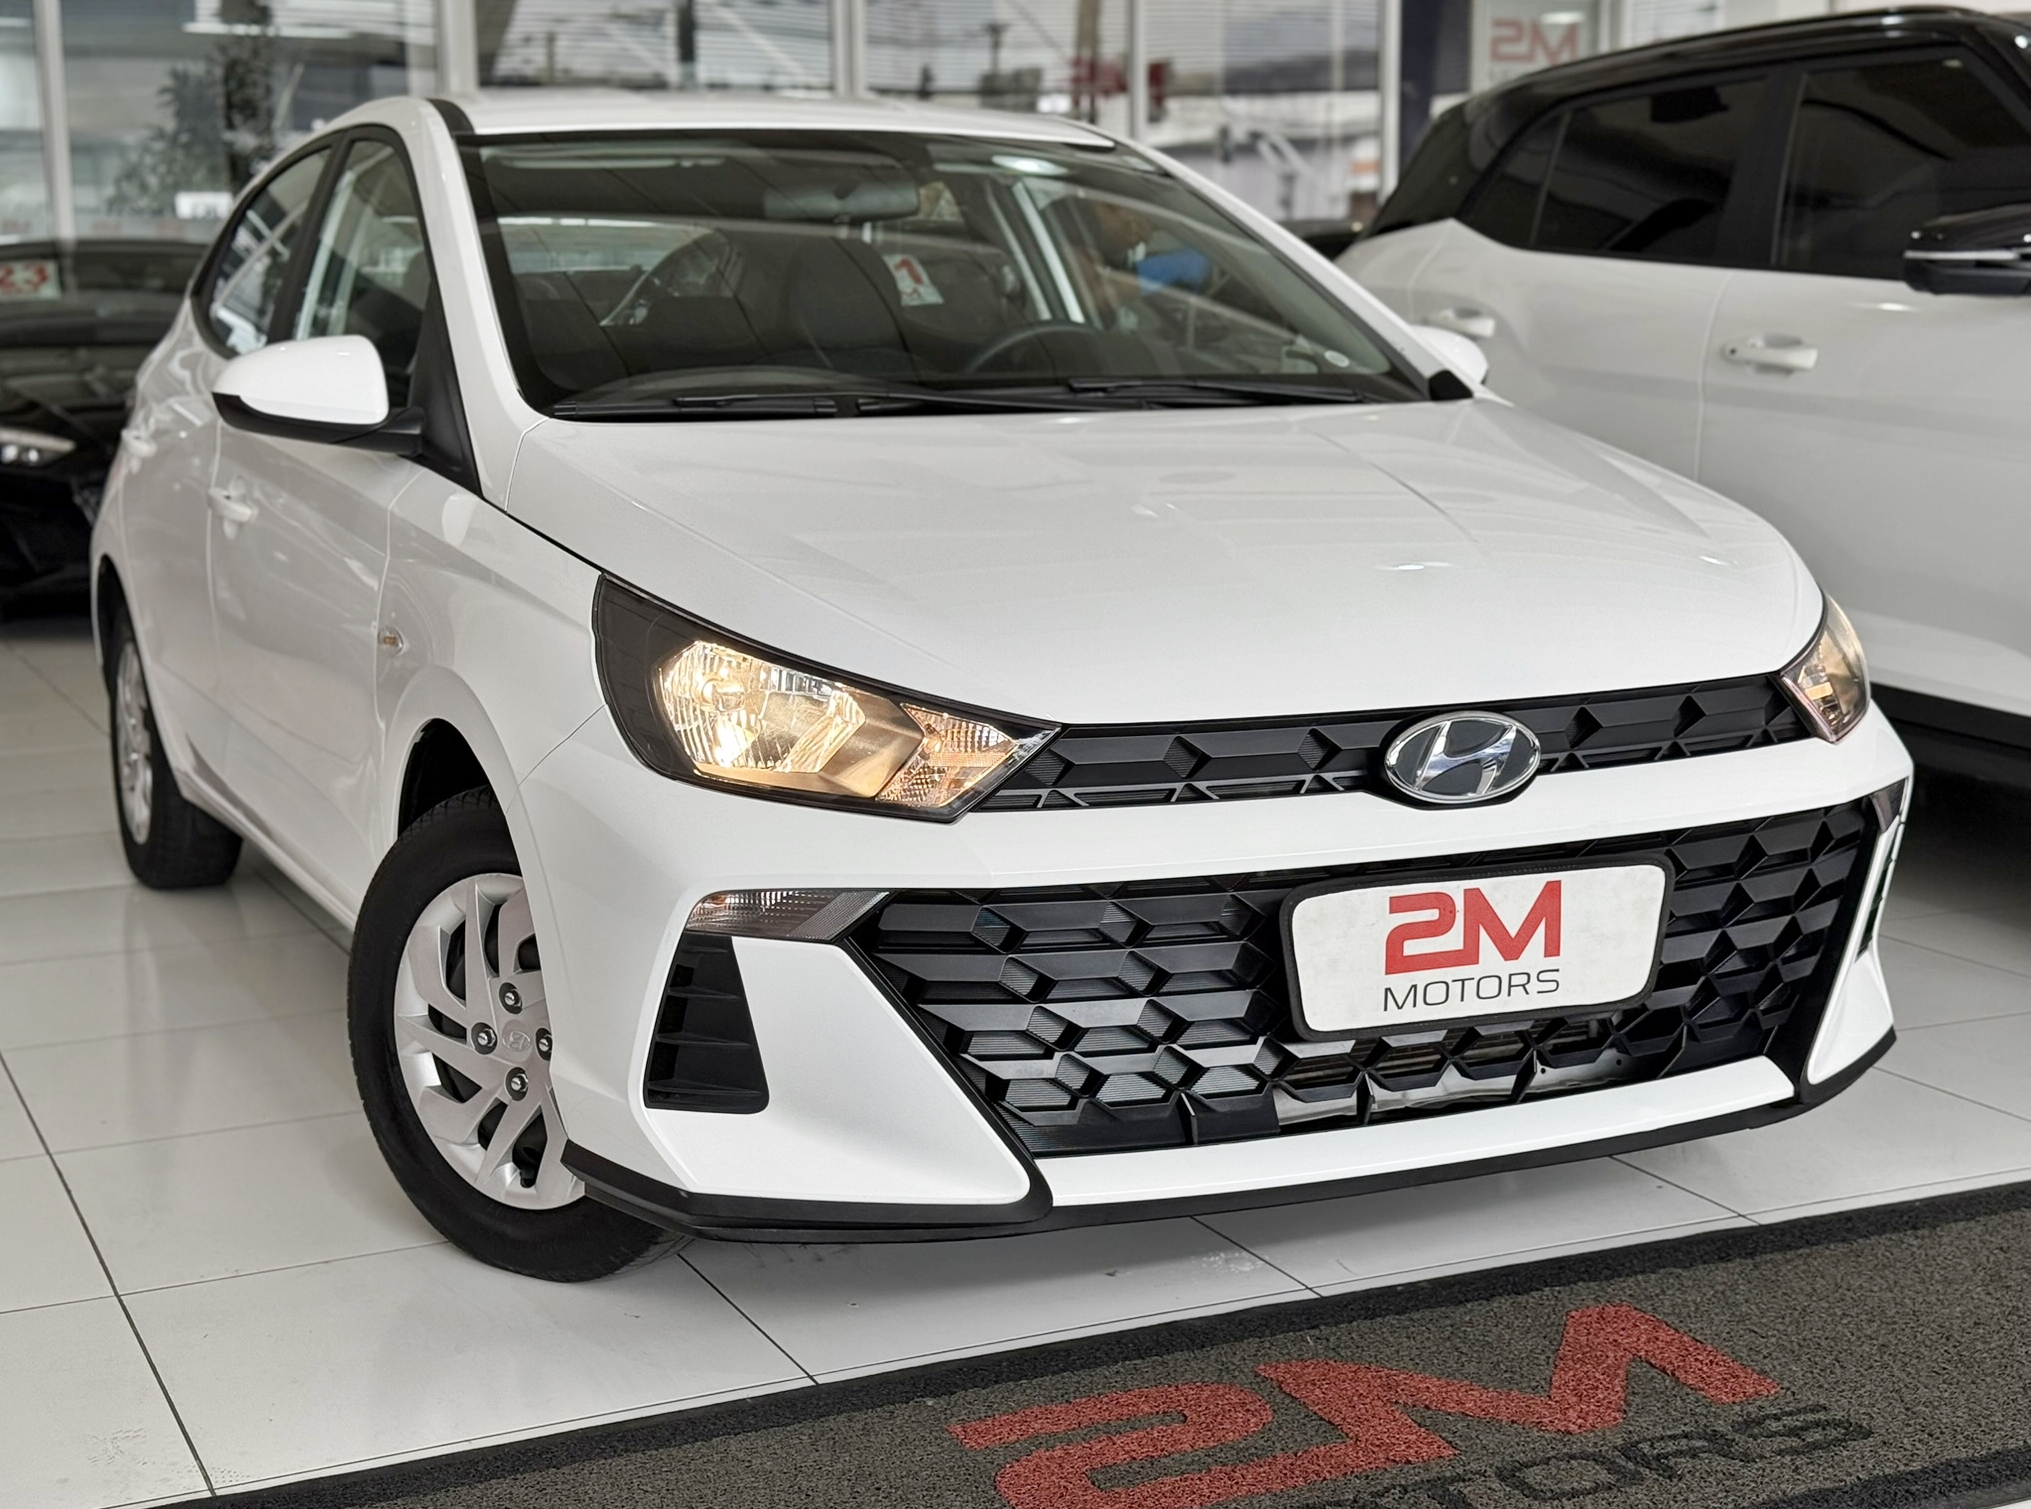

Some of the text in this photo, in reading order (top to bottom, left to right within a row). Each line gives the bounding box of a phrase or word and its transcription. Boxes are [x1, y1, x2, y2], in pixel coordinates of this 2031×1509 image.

[1385, 880, 1562, 975] 2M
[1383, 968, 1560, 1012] MOTORS
[949, 1303, 1779, 1509] 2M
